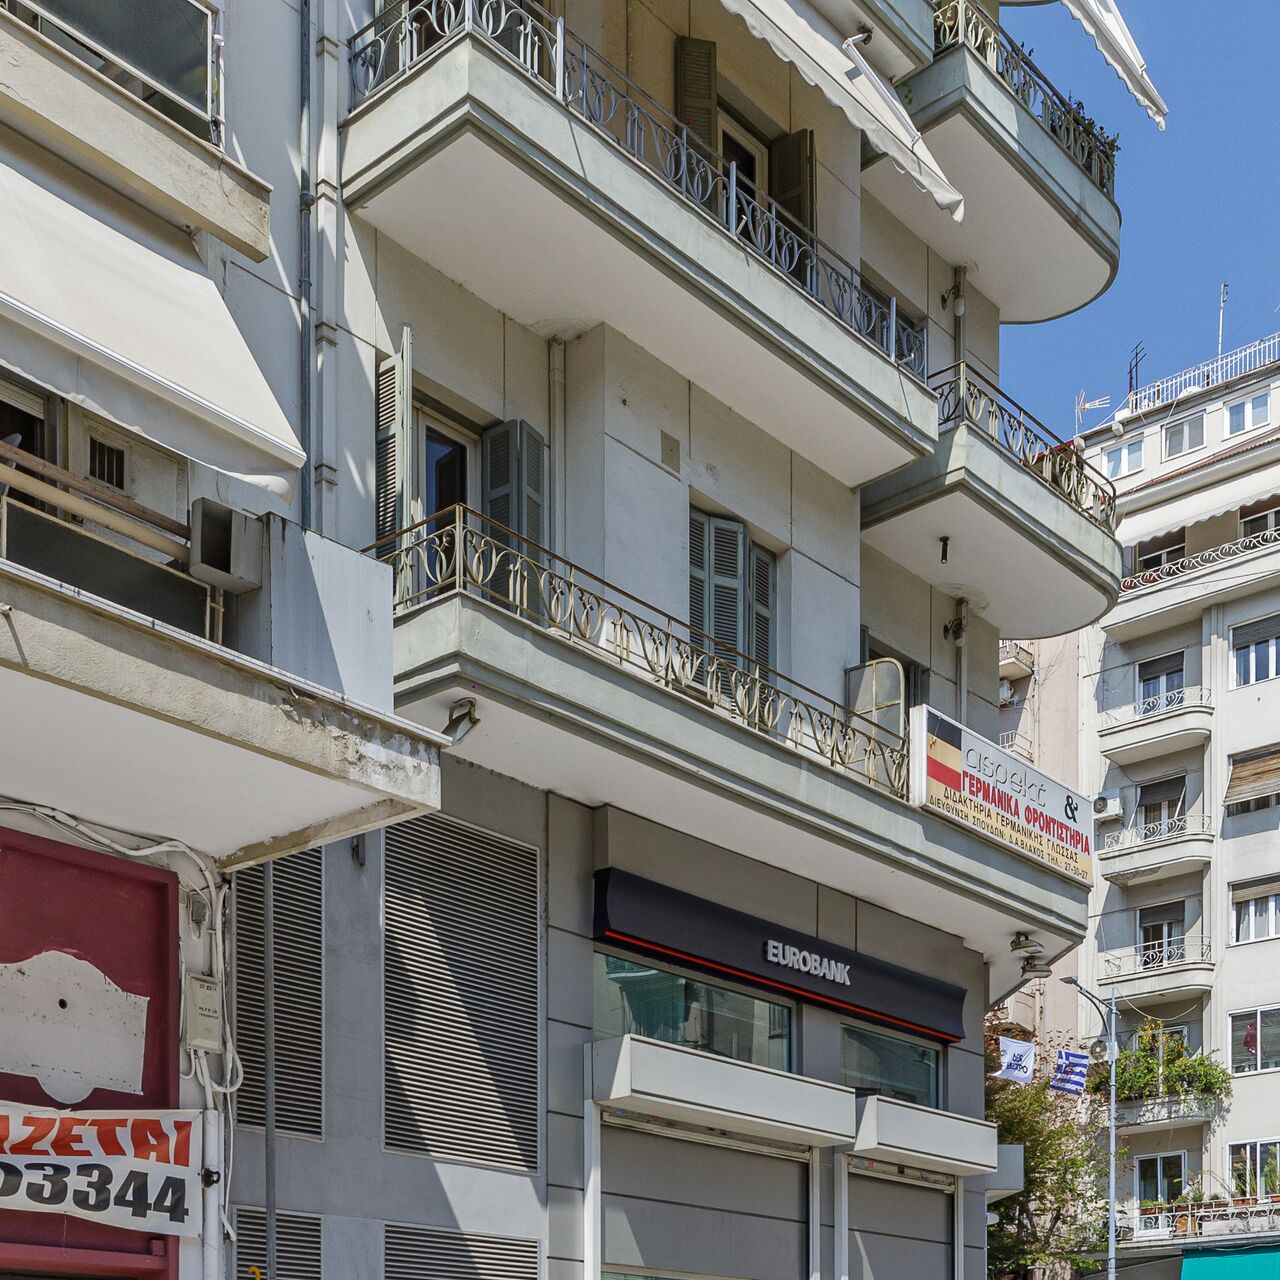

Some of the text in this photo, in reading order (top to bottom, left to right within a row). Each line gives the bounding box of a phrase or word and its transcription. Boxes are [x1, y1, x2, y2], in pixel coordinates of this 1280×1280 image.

[966, 748, 1047, 808] aspekt
[929, 795, 969, 823] ΔΙΕΥΘΥΝΣΗ
[943, 786, 1079, 864] ΔΙΔΑΚΤΗΡΙΑ ΓΕΡΜΑΝΙΚΗΣ ΓΛΩΣΣΑΣ
[962, 770, 1090, 856] ΓΕΡΜΑΝΙΚΑ ΦΡΟΝΤΙΣΤΗΡΙΑ
[1064, 794, 1079, 824] &
[767, 939, 851, 986] EUROBANK
